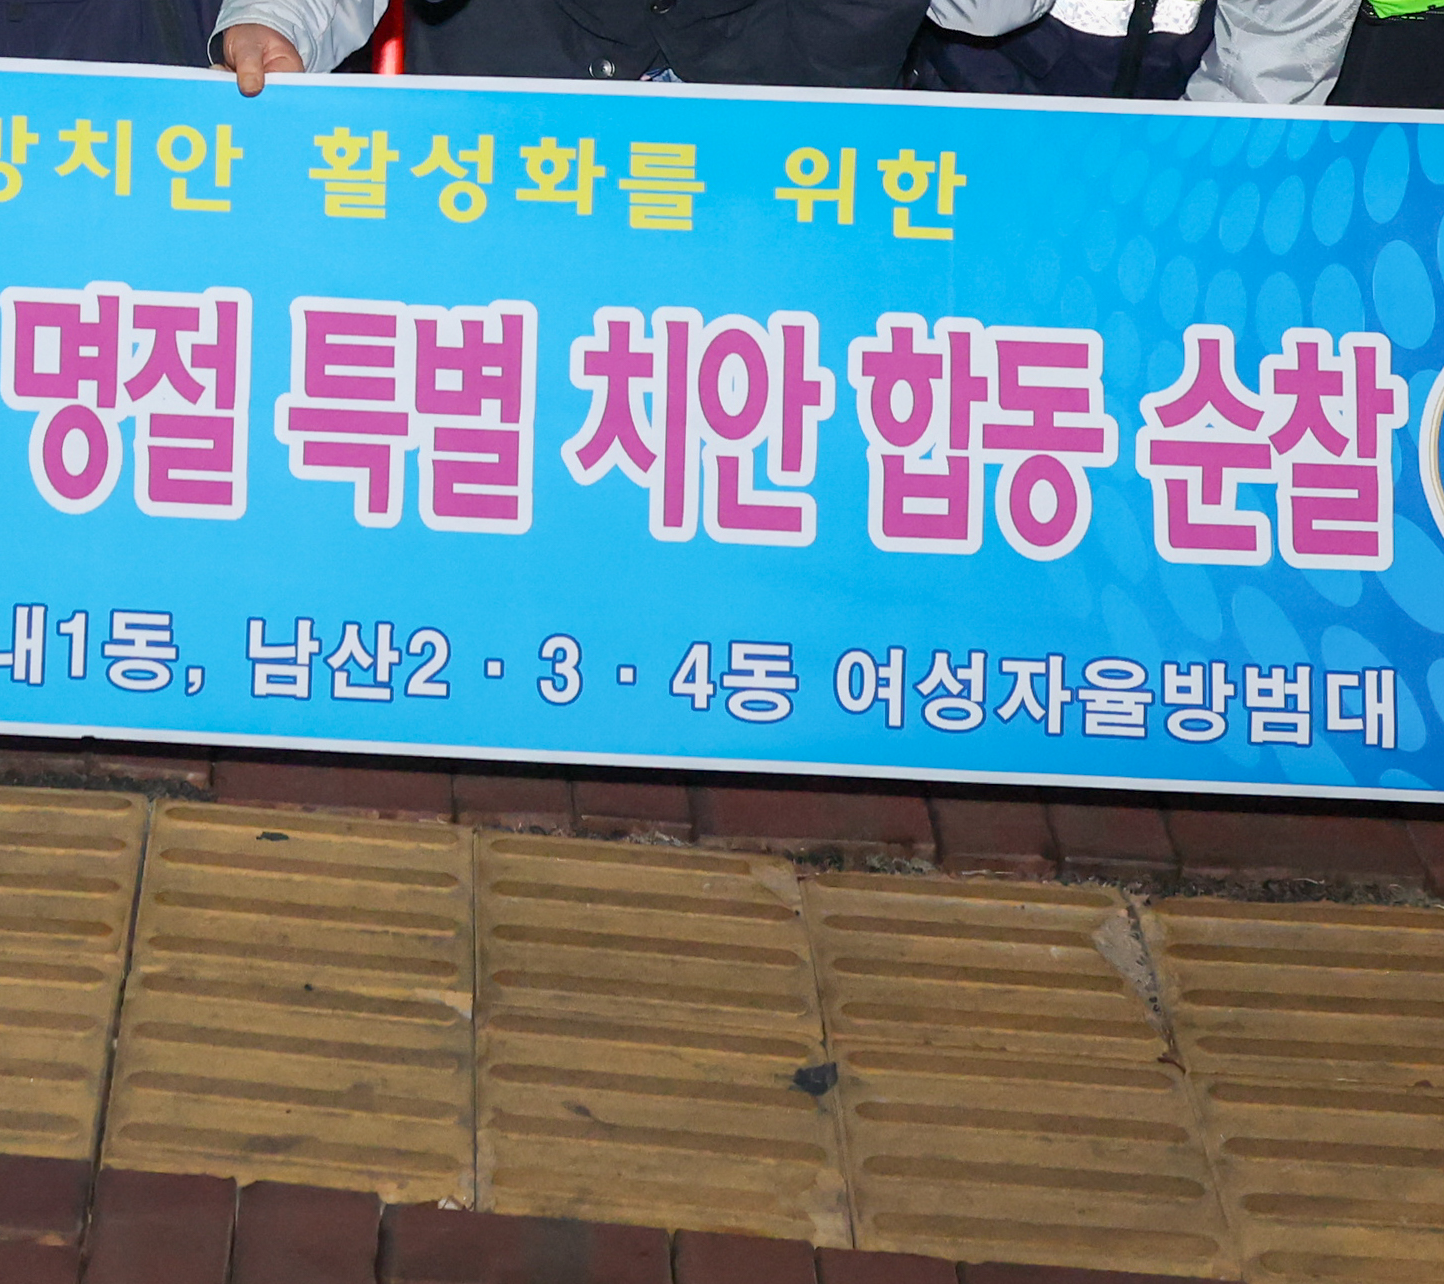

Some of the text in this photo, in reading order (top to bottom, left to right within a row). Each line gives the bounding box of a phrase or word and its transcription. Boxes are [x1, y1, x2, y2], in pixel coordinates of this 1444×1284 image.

[309, 125, 706, 231] 활성화를
[775, 146, 967, 241] 위한
[5, 286, 247, 515] 명절
[279, 301, 532, 529] 특별
[569, 312, 830, 541] 치안
[853, 318, 1113, 556] 합동
[1141, 329, 1403, 566] 순찰
[670, 640, 799, 724] 4동
[835, 645, 1399, 751] 여성자율방범대
